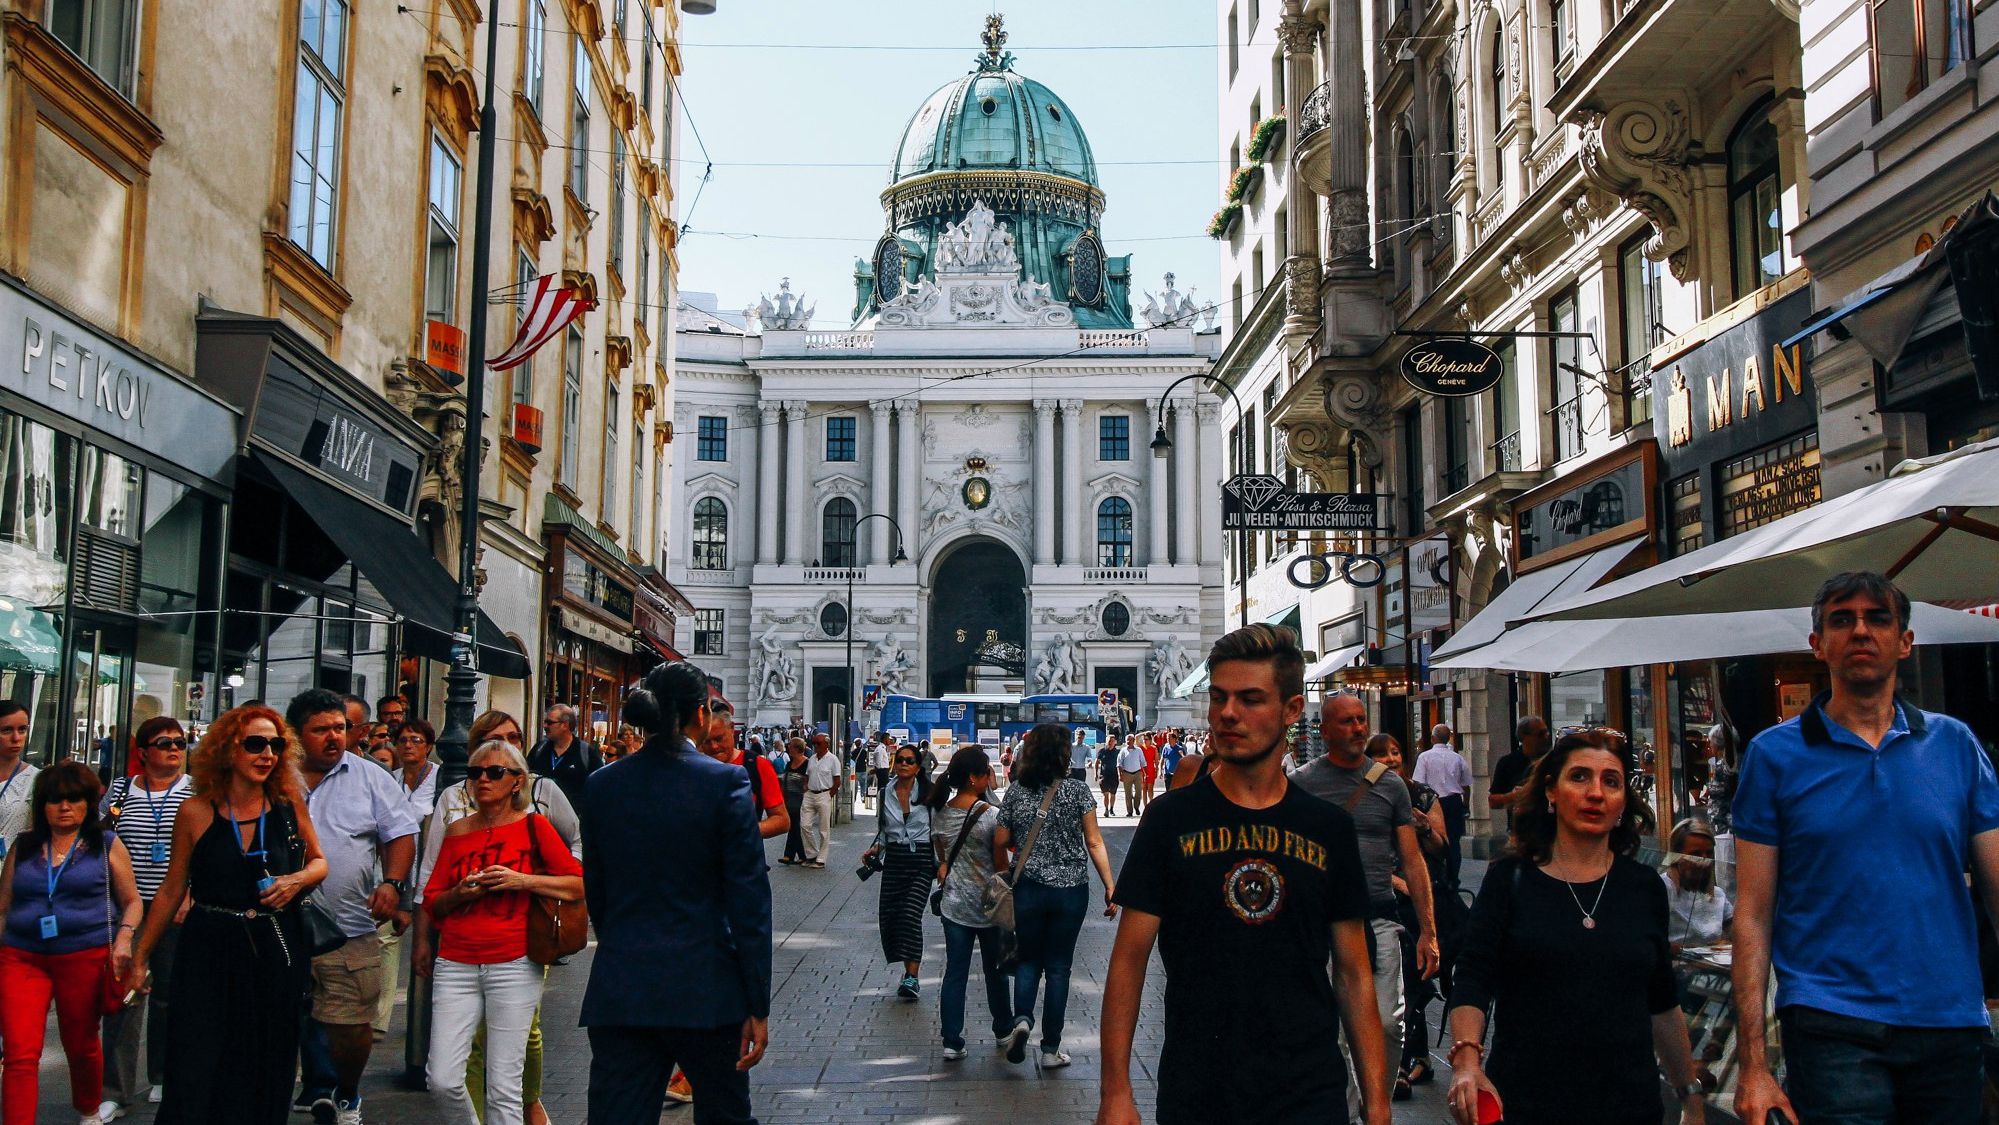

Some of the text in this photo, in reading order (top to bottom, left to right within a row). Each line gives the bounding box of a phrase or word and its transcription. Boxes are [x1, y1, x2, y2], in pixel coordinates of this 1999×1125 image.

[23, 316, 150, 428] PETKOV
[1410, 351, 1492, 378] Chopard
[1271, 494, 1304, 512] Kiss
[1309, 501, 1322, 512] &
[1179, 824, 1329, 871] WILD AND FREE
